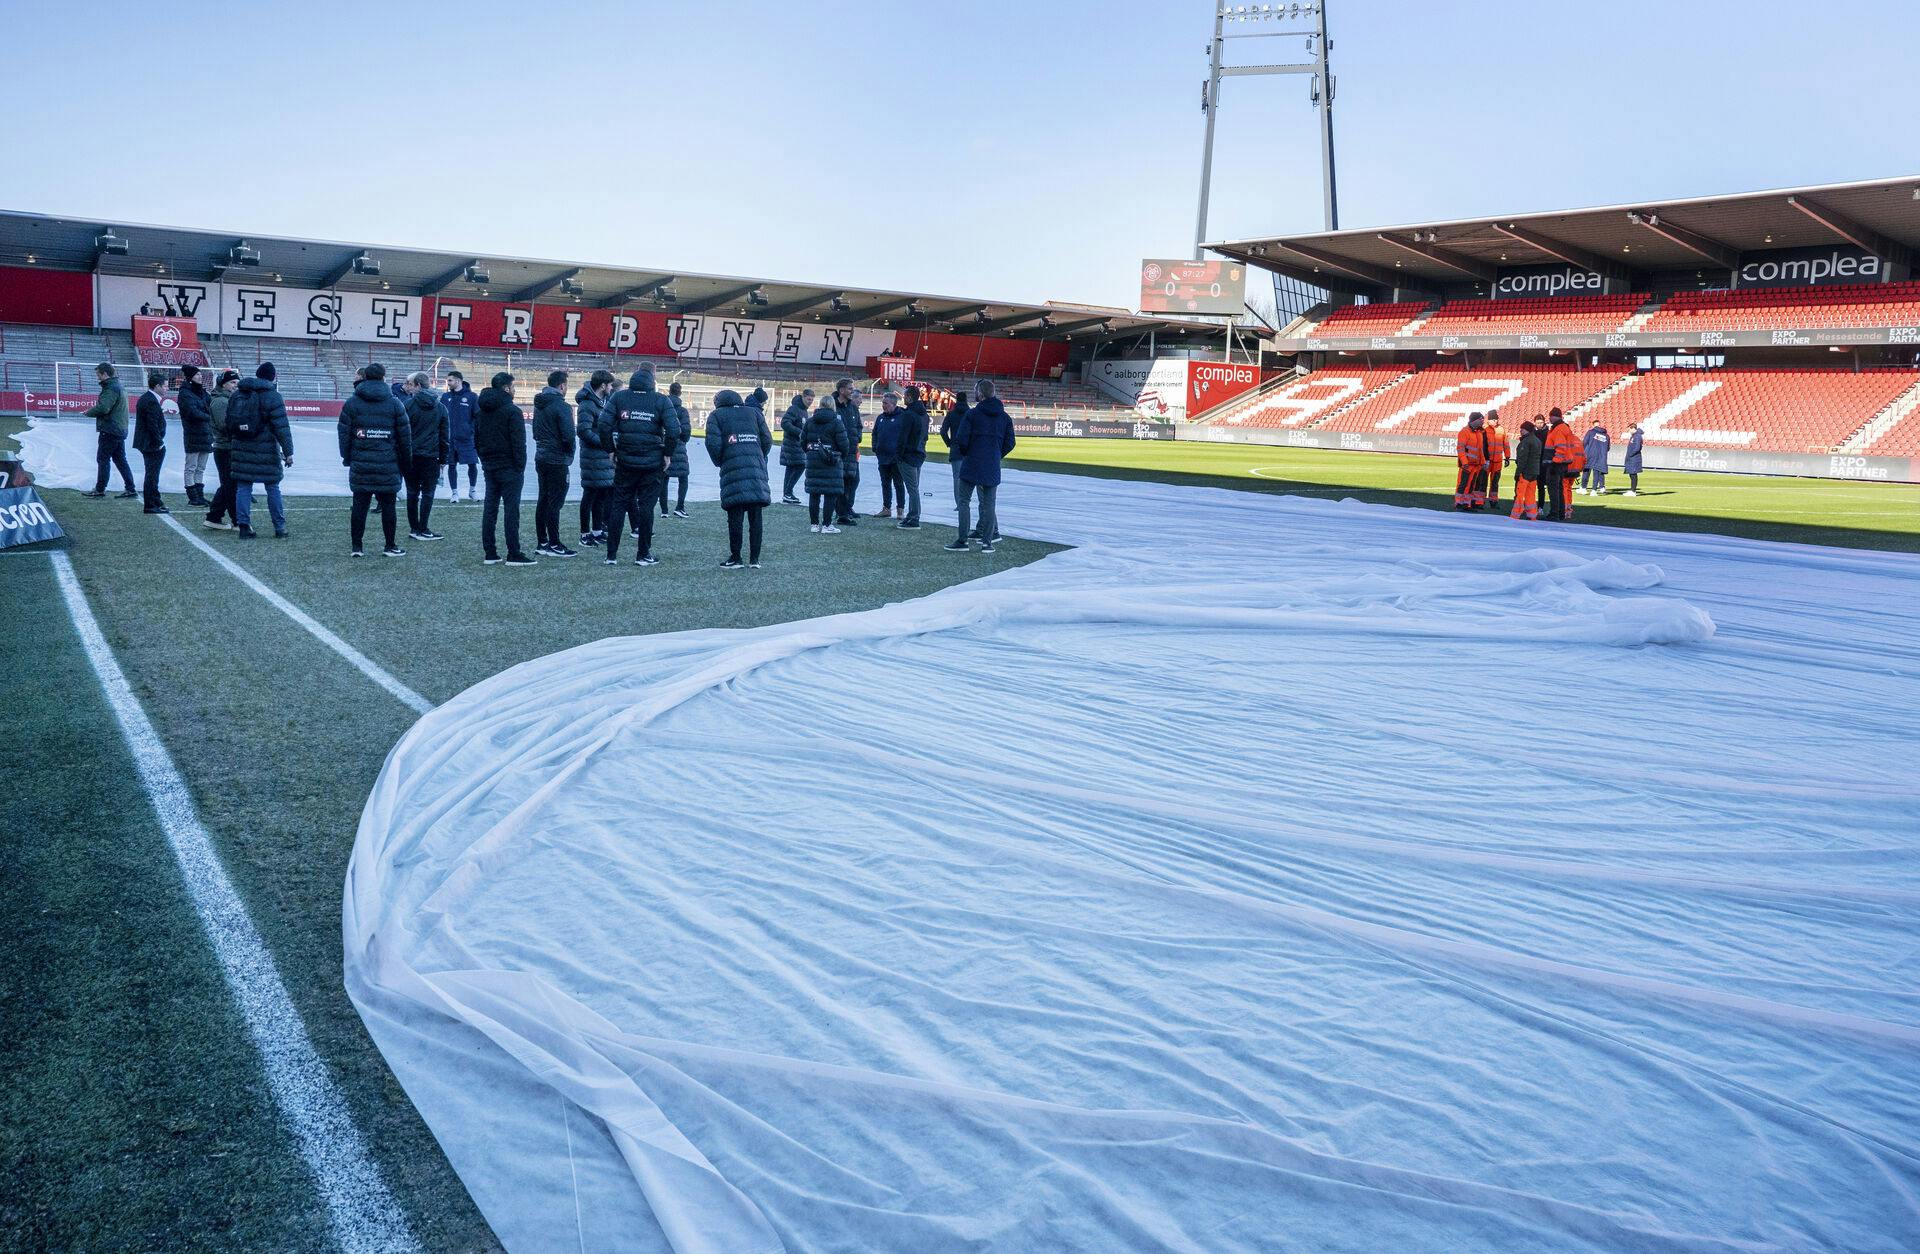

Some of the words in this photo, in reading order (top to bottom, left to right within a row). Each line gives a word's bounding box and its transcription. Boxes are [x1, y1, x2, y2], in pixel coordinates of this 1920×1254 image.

[1743, 252, 1880, 284] complea
[1499, 268, 1602, 295] complea
[1165, 282, 1175, 296] 0
[1211, 283, 1220, 297] 0
[1816, 332, 1883, 341] Messestande
[1889, 328, 1917, 336] EXPO
[1557, 337, 1597, 346] Vejledning
[1700, 338, 1736, 346] PARTNER
[1771, 337, 1810, 345] PARTNER
[883, 363, 912, 380] 1885
[1196, 366, 1253, 385] complea
[1055, 421, 1073, 429] EXPO
[1054, 428, 1083, 436] PARTNER
[1089, 426, 1127, 434] Showrooms
[1133, 430, 1158, 439] PARTNER
[1341, 433, 1362, 441] EXPO
[1341, 440, 1373, 449] PARTNER
[1378, 438, 1433, 449] Messestande
[1680, 450, 1709, 459] EXPO
[1679, 458, 1727, 470] PARTNER
[1830, 457, 1866, 466] EXPO
[1830, 466, 1888, 478] PARTNER
[0, 502, 54, 531] cron
